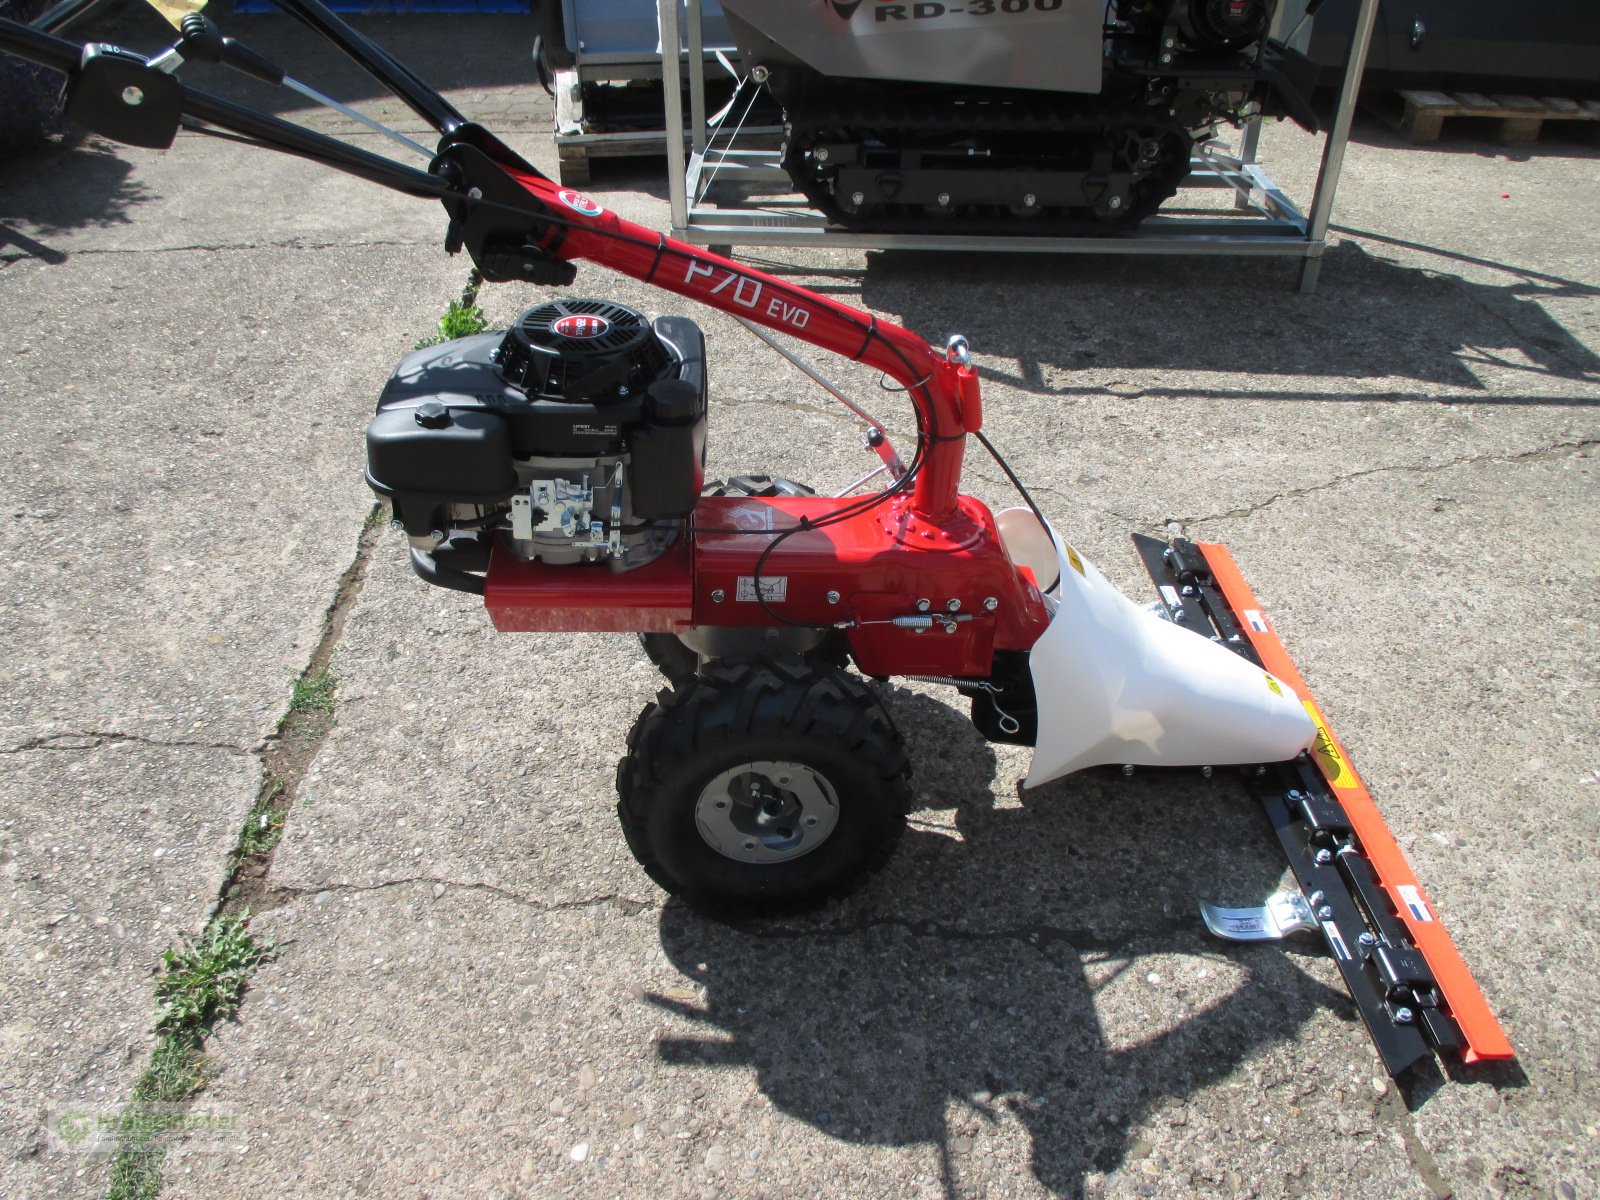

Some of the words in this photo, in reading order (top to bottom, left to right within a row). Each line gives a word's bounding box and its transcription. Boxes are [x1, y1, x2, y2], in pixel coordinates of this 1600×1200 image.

[874, 0, 1063, 22] RD-300
[684, 260, 763, 308] P70
[766, 298, 810, 328] EVO
